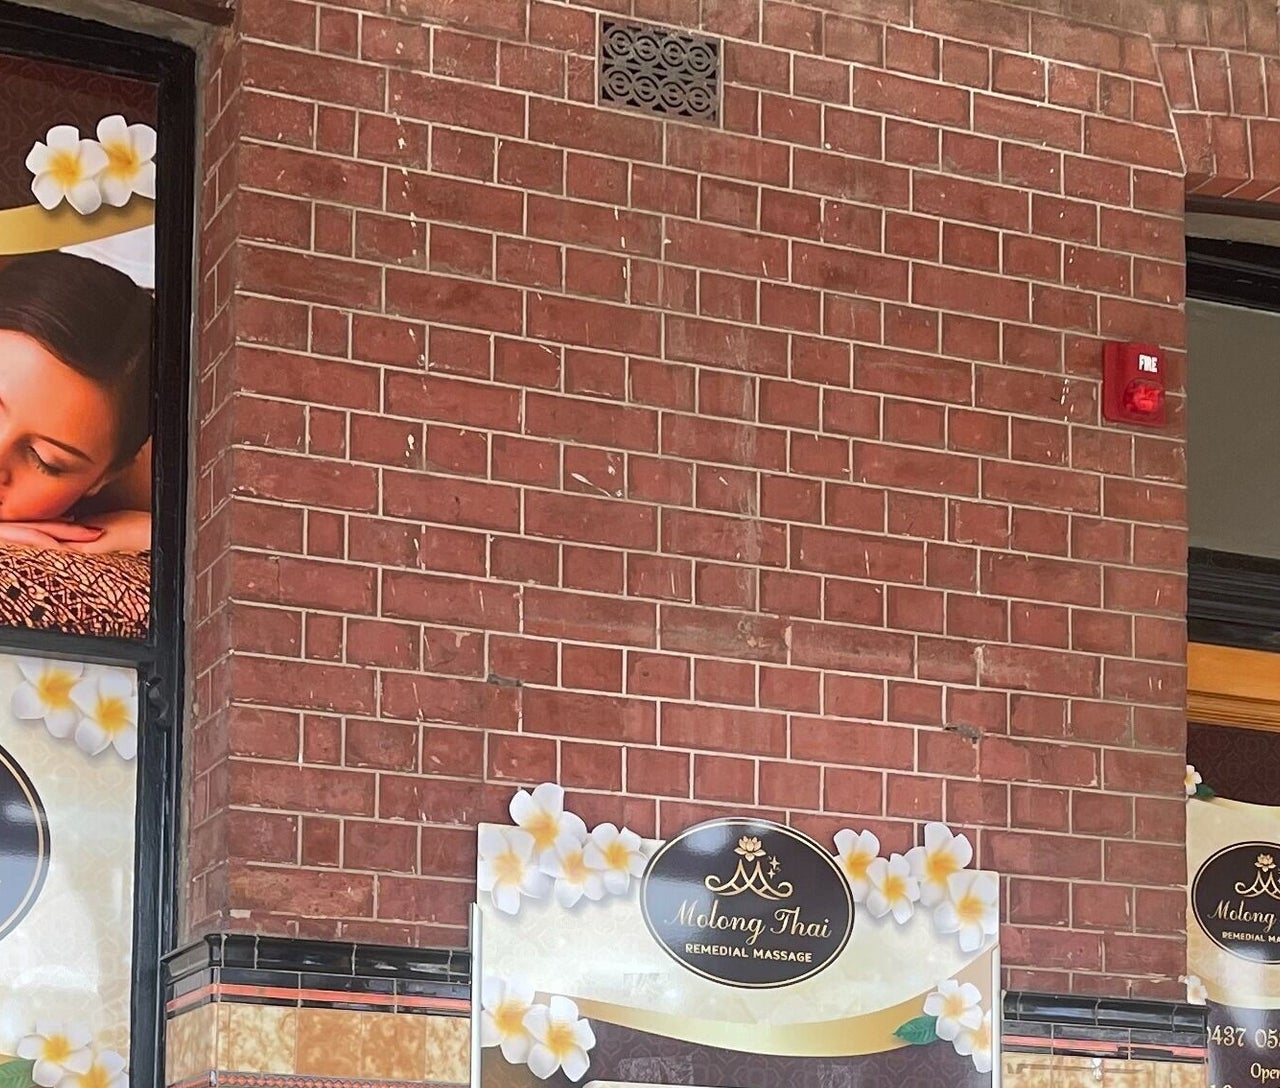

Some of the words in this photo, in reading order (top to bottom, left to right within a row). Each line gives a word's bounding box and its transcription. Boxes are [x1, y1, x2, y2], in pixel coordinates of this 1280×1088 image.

[663, 899, 766, 946] Molong
[769, 906, 832, 939] Thai
[1207, 900, 1277, 933] Molong
[1221, 931, 1264, 943] REMEDIAL
[685, 943, 749, 958] REMEDIAL
[753, 949, 813, 963] MASSAGE
